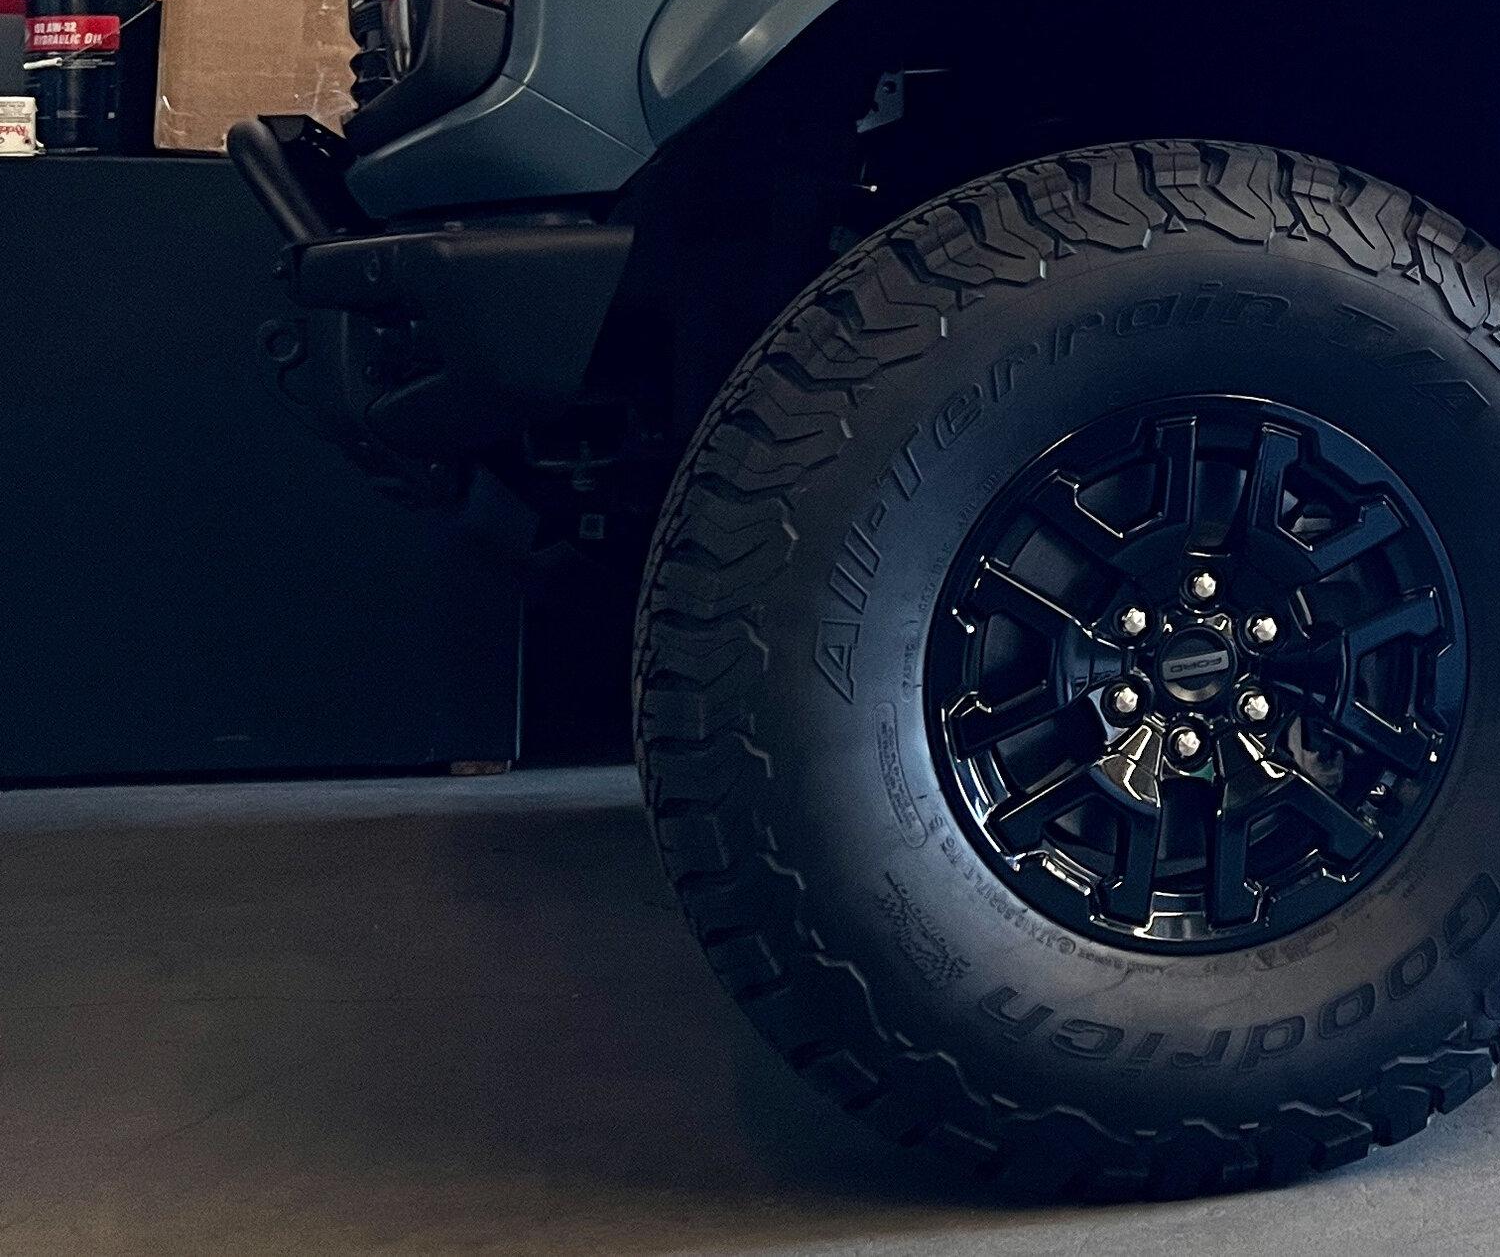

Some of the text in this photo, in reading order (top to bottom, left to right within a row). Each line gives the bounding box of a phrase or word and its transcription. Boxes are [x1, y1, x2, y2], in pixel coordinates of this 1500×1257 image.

[84, 32, 102, 45] OIL
[814, 280, 1292, 704] All-Terrain
[1170, 657, 1222, 673] FORD
